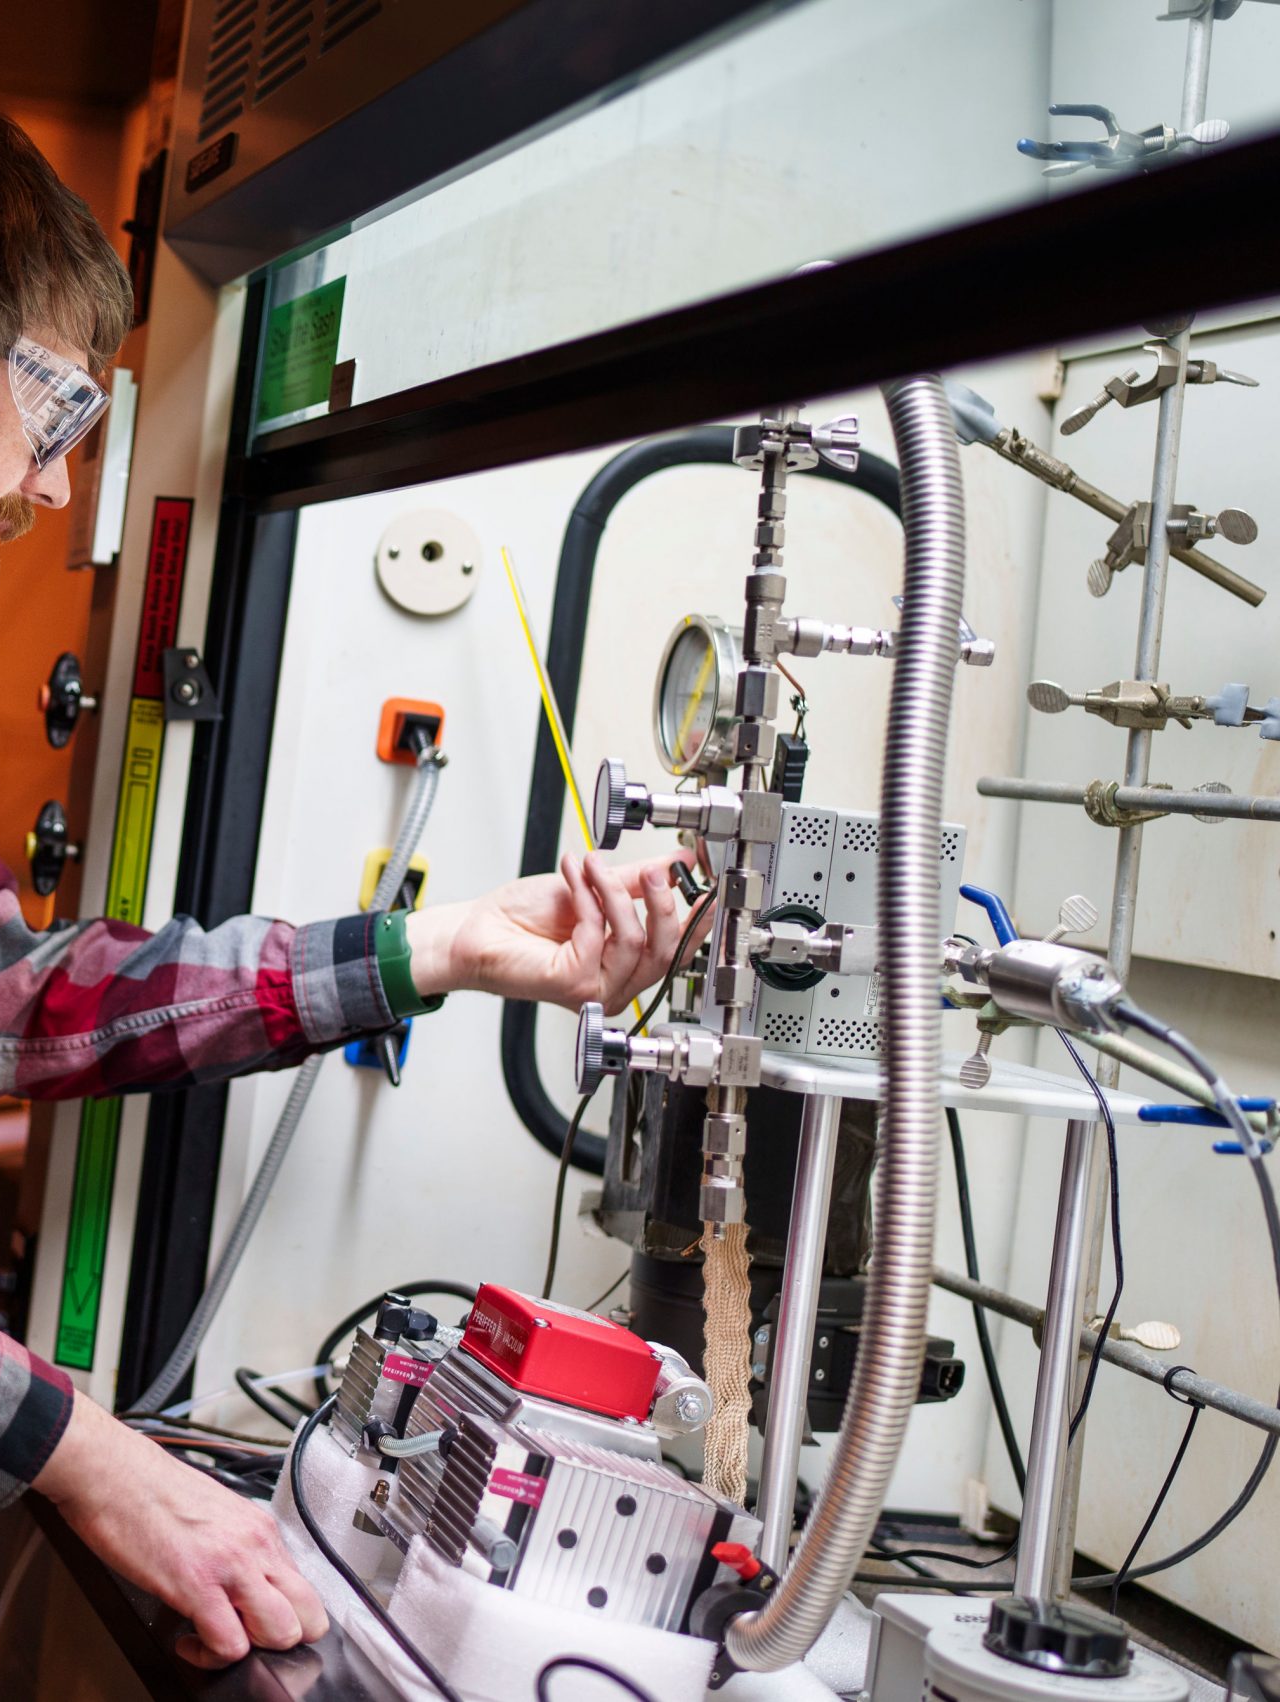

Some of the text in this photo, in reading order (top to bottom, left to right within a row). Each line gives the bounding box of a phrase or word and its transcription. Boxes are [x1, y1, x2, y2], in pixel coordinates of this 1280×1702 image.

[472, 1308, 525, 1357] PFEIFFER VACUUM
[384, 1366, 411, 1379] PFEIFFER
